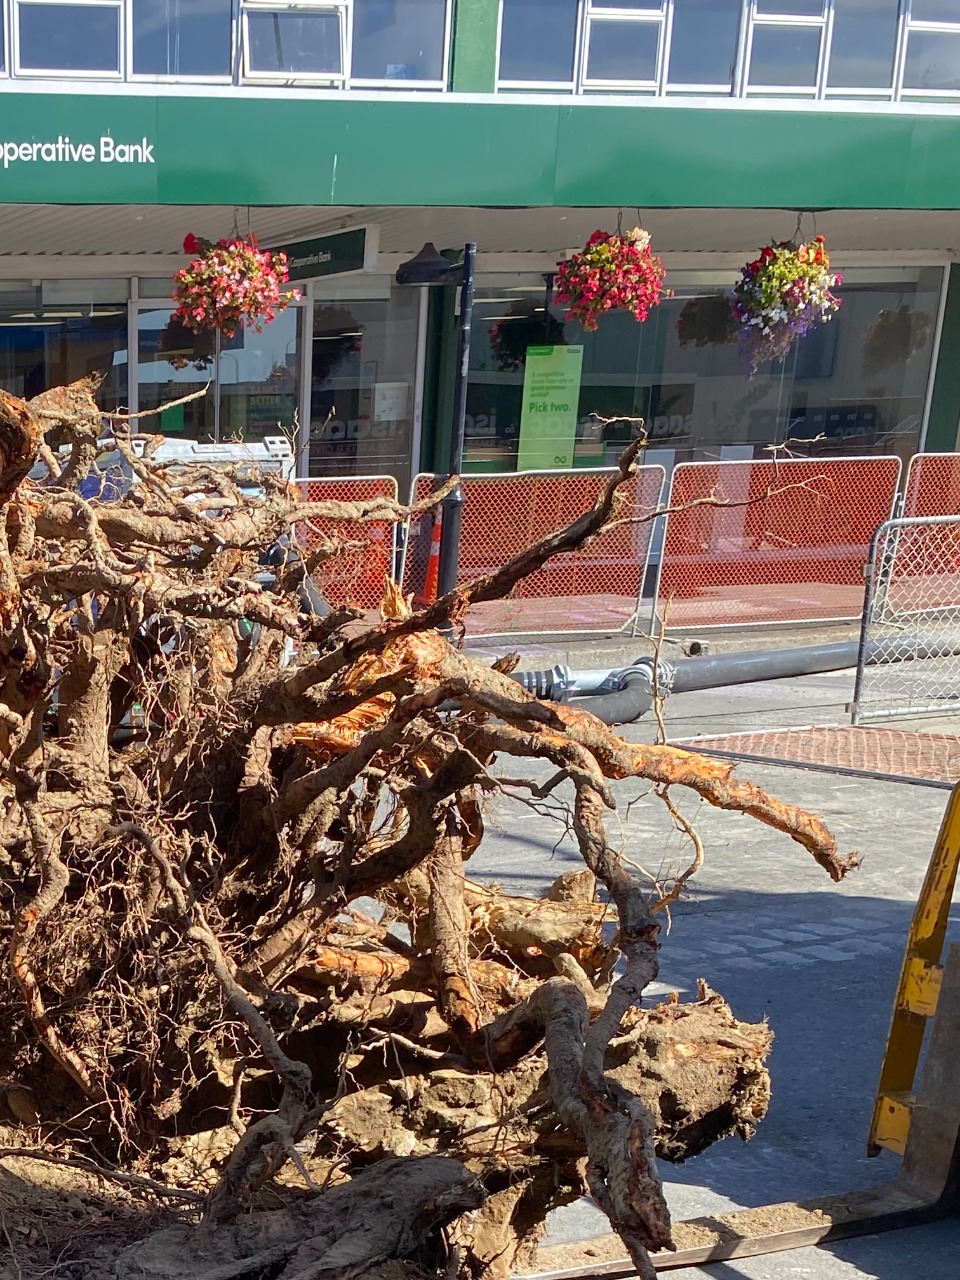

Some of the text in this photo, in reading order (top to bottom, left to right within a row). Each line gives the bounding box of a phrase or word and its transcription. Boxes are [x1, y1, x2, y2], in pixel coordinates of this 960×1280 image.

[99, 136, 155, 163] Bank
[529, 401, 572, 413] Pick two.
